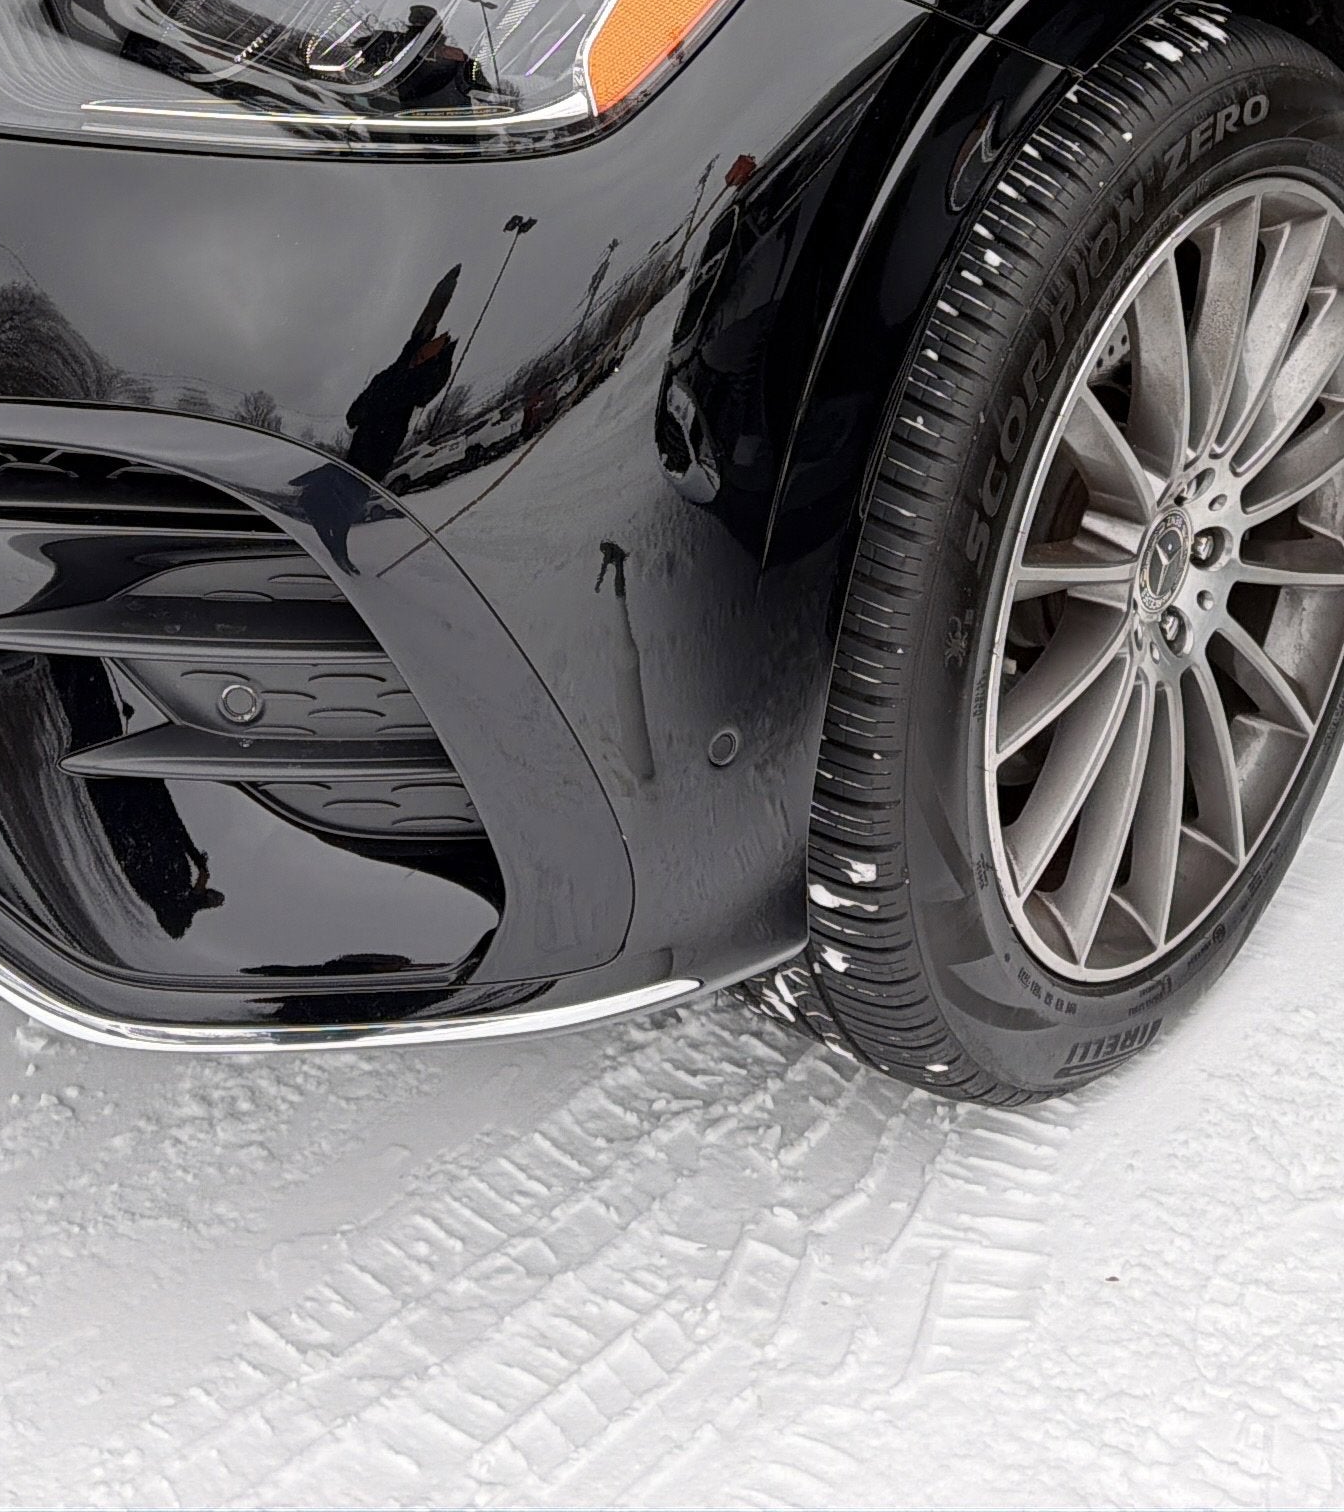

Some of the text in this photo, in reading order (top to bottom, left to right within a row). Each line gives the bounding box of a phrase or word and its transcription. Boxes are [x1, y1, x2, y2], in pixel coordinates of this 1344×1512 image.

[969, 178, 1145, 576] SCORPION
[1161, 92, 1271, 182] ZERO
[1054, 1018, 1164, 1078] PIRELLI
